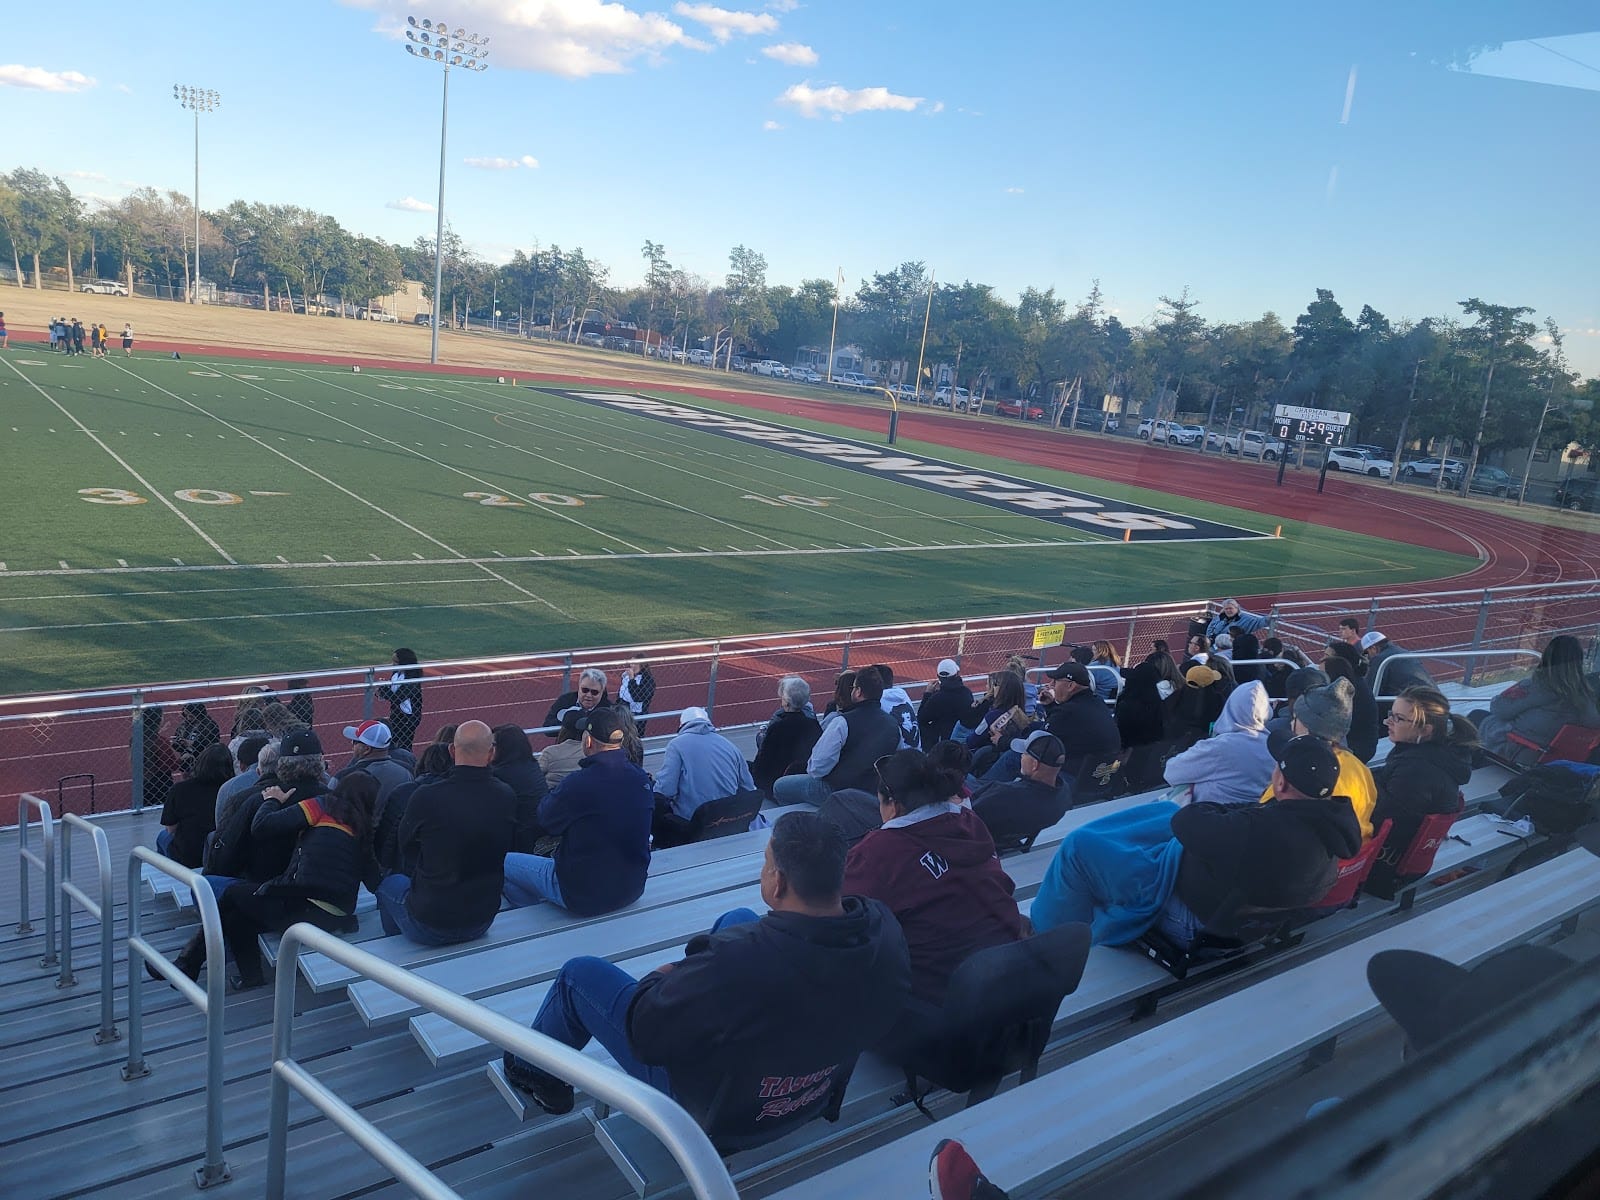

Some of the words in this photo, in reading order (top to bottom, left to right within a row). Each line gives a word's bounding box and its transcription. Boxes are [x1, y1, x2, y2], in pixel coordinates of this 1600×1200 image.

[1274, 417, 1292, 425] HOME
[1280, 426, 1288, 438] 0
[1299, 421, 1325, 435] 0:29
[1325, 424, 1345, 433] GUEST
[919, 850, 949, 880] W
